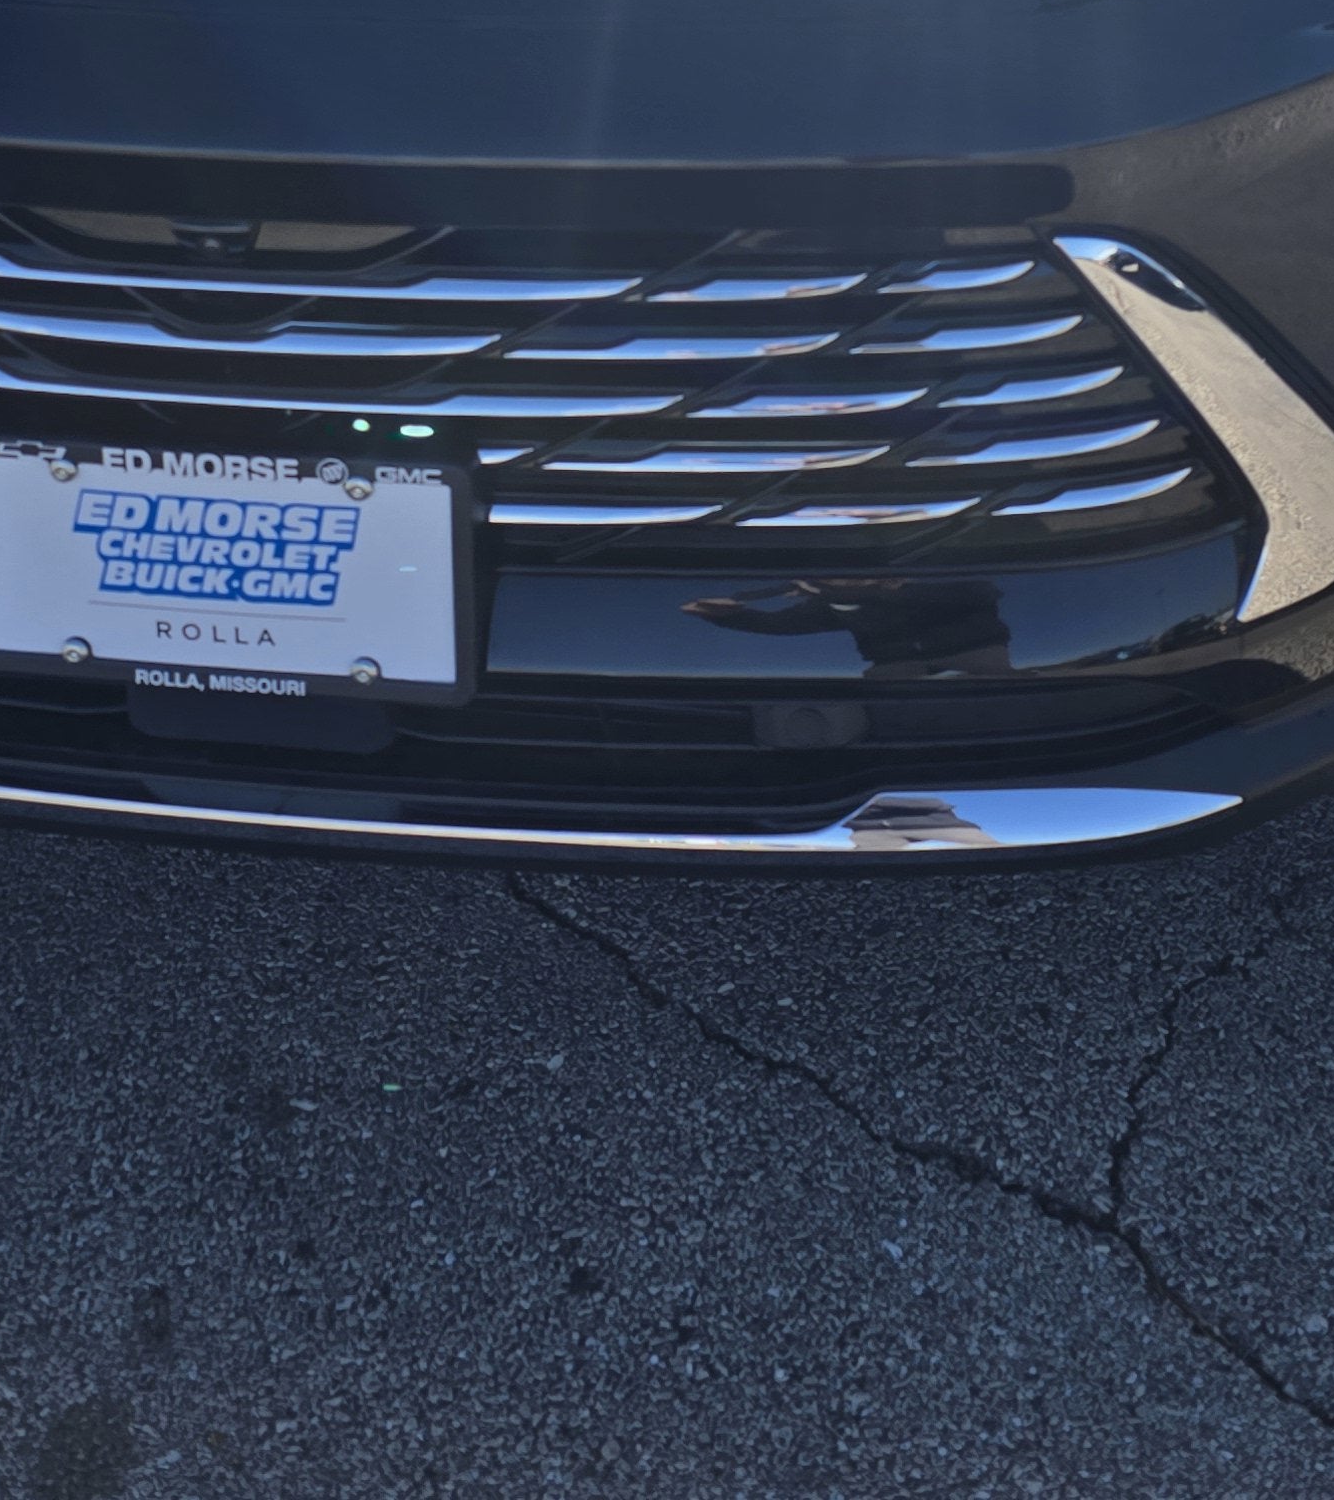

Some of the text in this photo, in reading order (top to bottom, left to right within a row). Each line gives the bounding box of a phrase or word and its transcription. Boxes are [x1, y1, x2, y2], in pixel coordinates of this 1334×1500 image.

[101, 446, 300, 482] ED MORSE
[374, 465, 443, 485] GMC
[76, 491, 359, 544] ED MORSE
[155, 620, 276, 647] ROLLA
[134, 668, 307, 697] ROLLA, MISSOURI
